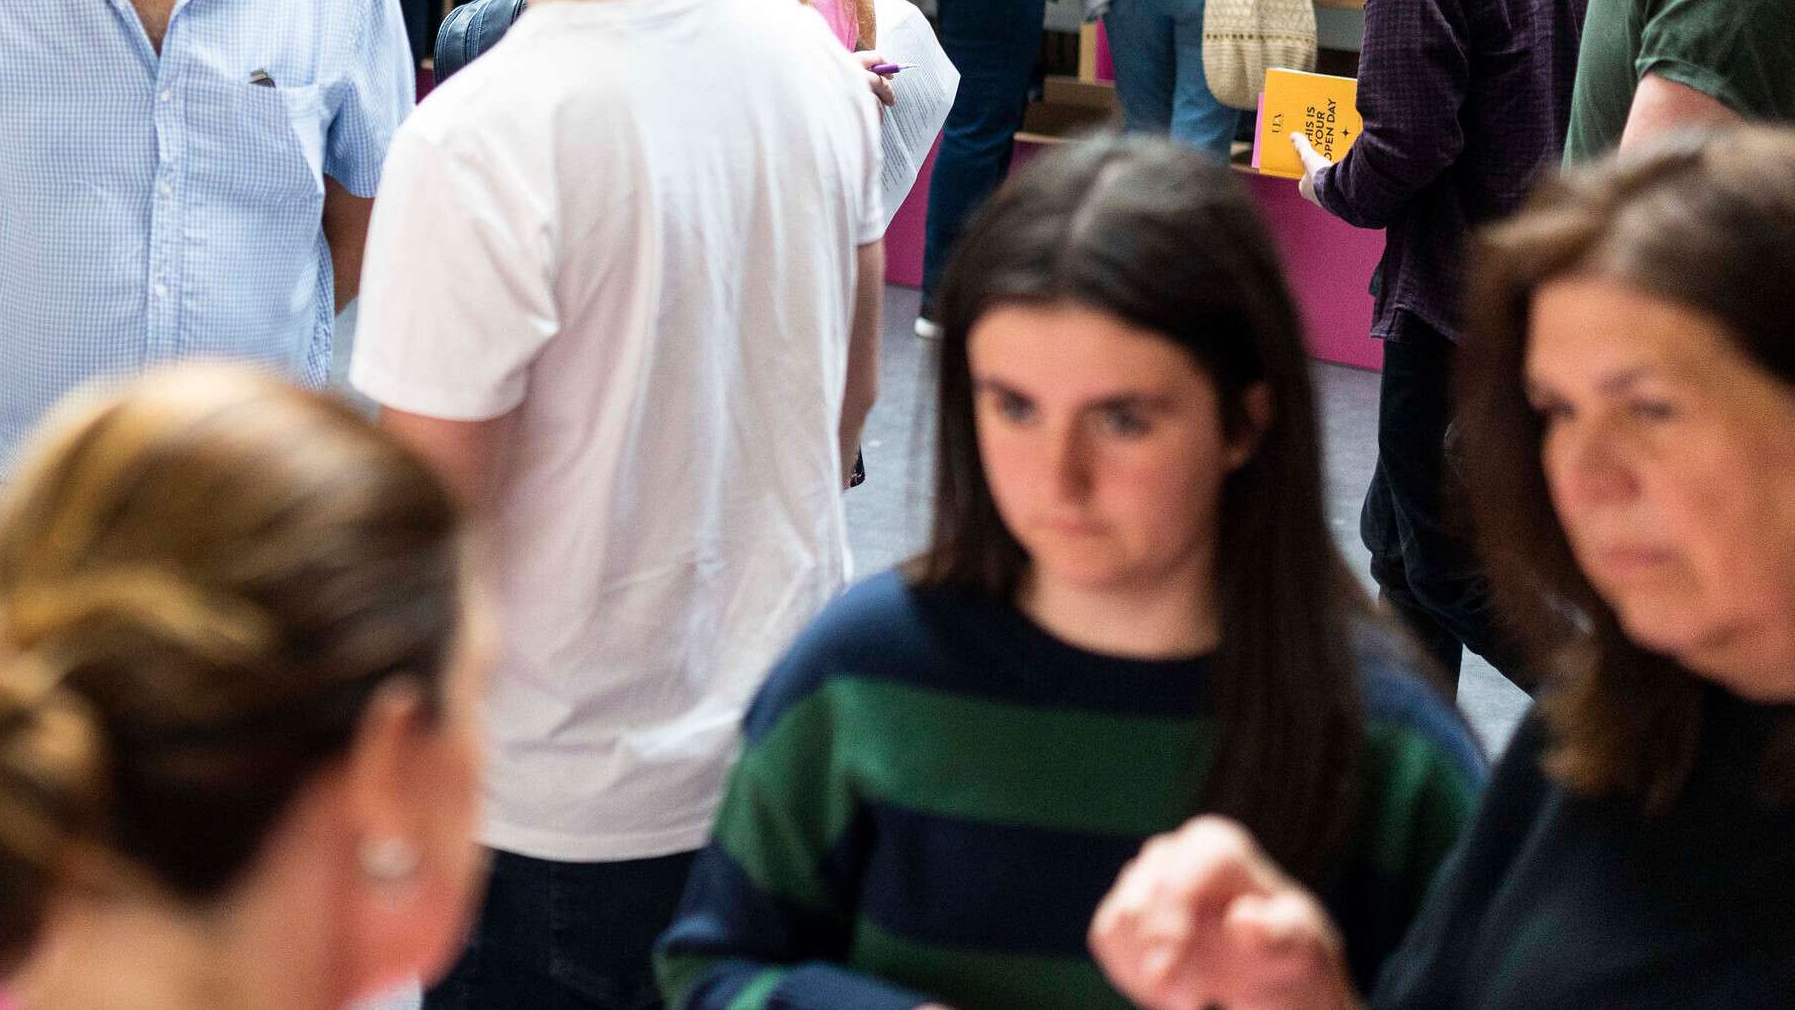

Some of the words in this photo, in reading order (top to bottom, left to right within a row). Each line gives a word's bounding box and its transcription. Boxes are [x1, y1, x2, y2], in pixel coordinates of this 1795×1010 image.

[1307, 106, 1316, 118] IS
[1327, 98, 1337, 124] DAY
[1315, 112, 1325, 147] YOUR
[1324, 126, 1335, 161] OPEN
